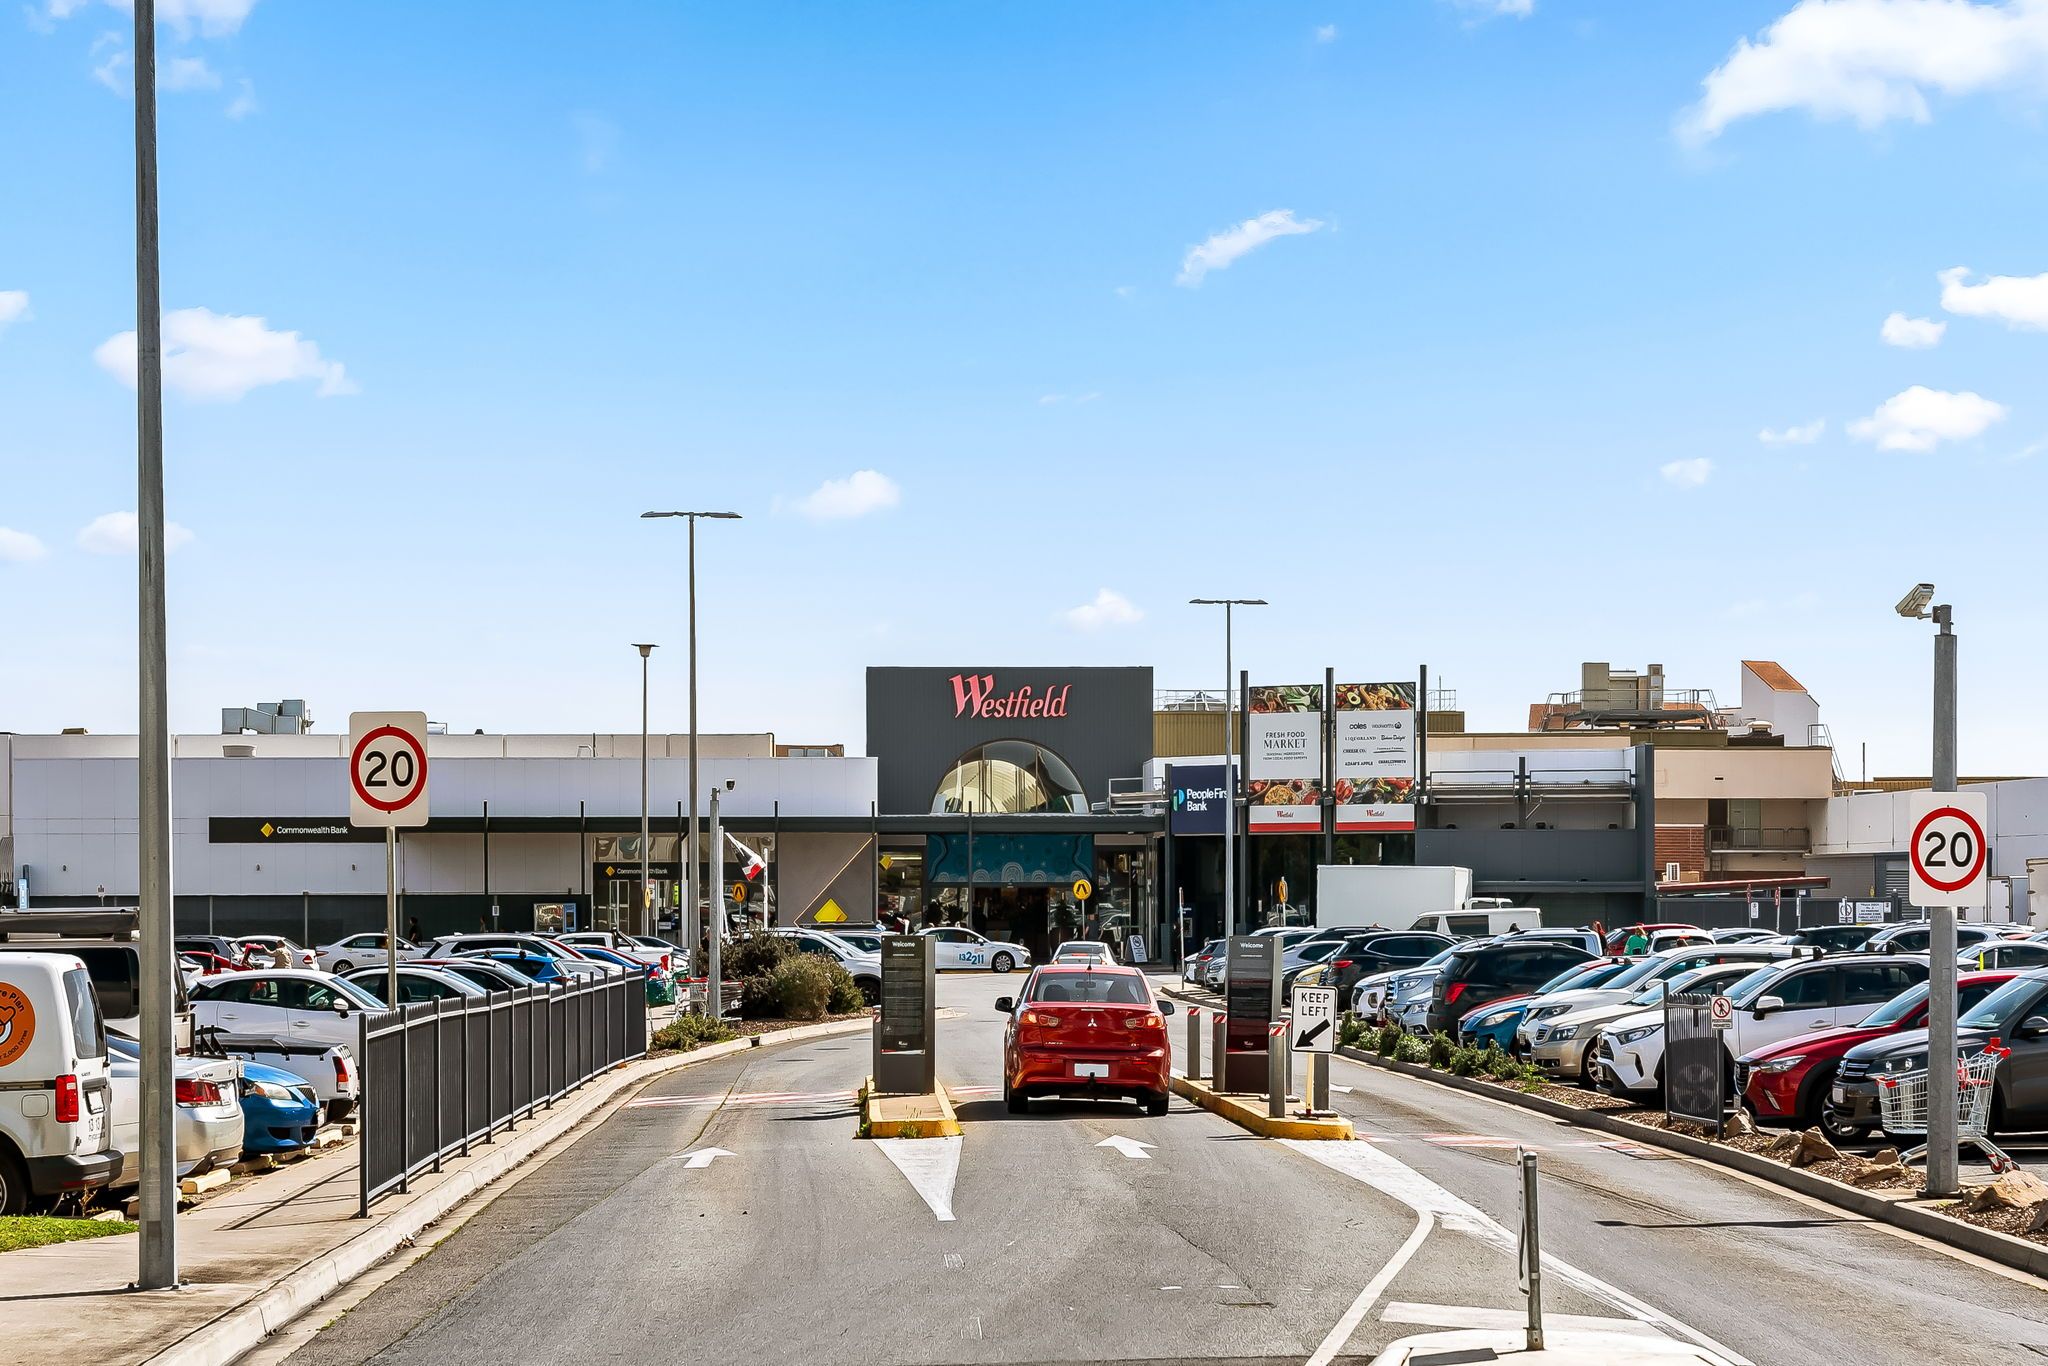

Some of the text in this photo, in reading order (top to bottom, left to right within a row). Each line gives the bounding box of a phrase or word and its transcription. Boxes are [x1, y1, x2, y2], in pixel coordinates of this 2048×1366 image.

[949, 674, 1073, 719] Westfield
[1263, 738, 1308, 749] MARKET
[364, 750, 414, 787] 20
[1186, 787, 1227, 800] People Firs
[1187, 801, 1207, 811] Bank
[276, 826, 348, 834] Commonwealth Bank
[1924, 831, 1973, 867] 20
[8, 992, 25, 1012] Plan
[1301, 992, 1330, 1003] KEEP
[1301, 1006, 1328, 1017] LEFT
